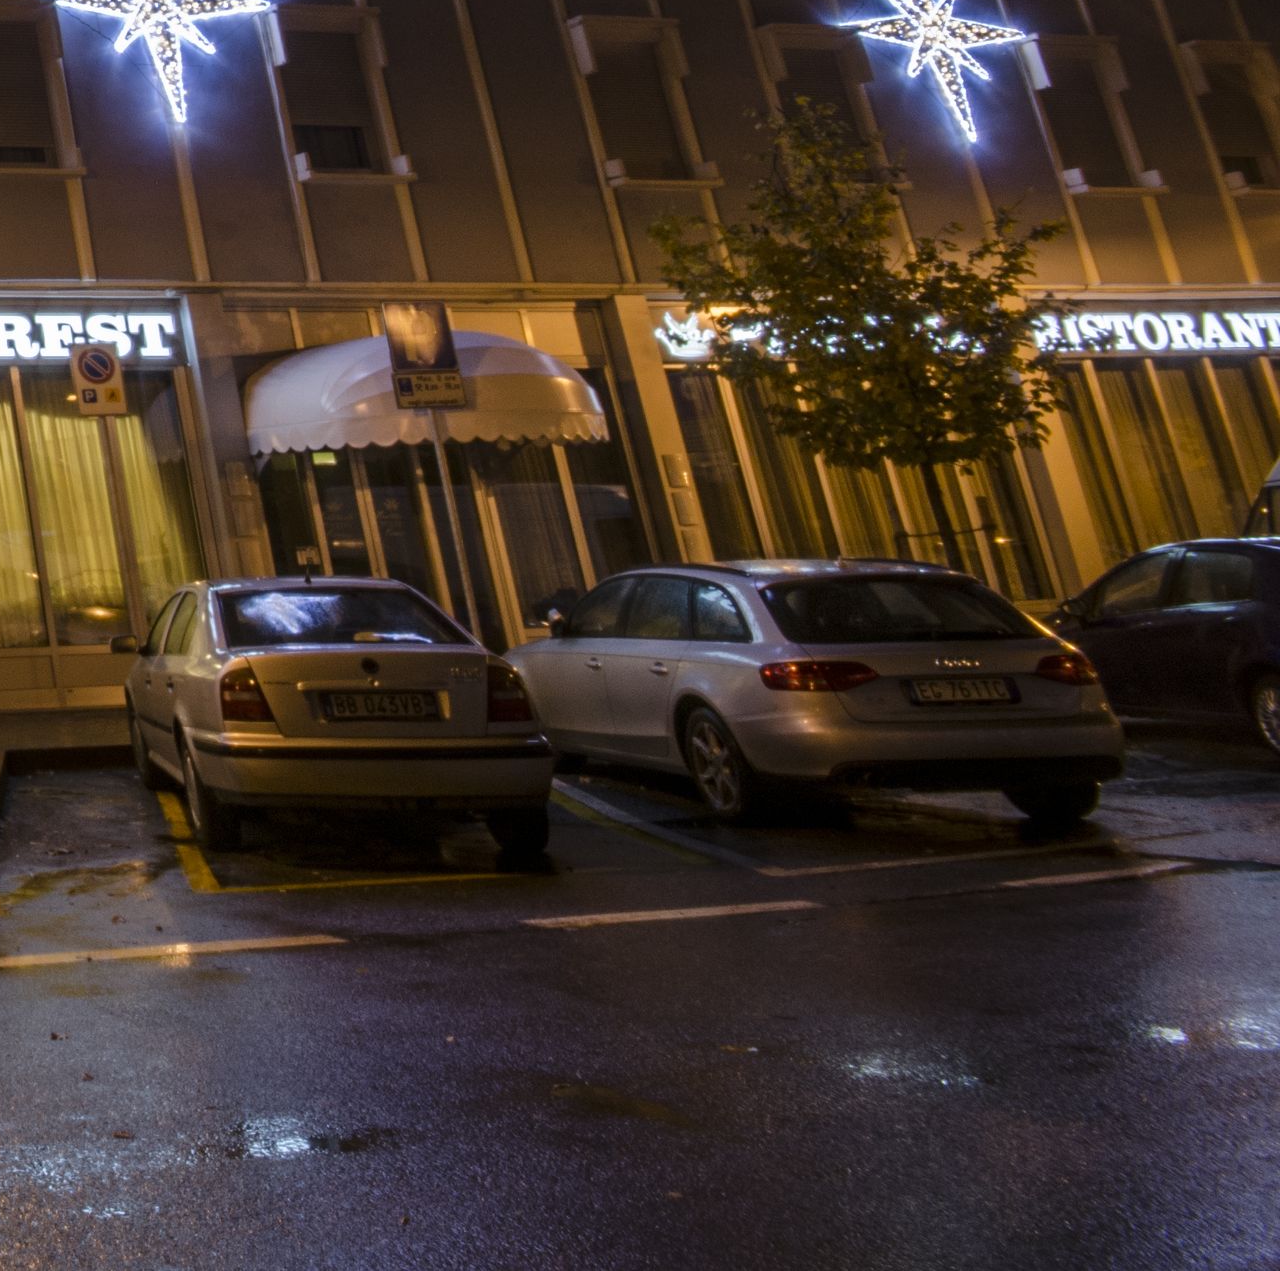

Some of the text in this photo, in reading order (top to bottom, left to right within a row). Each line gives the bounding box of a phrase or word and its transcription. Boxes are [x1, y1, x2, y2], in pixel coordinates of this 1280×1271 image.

[84, 390, 95, 403] P
[333, 693, 423, 715] BB 043VB
